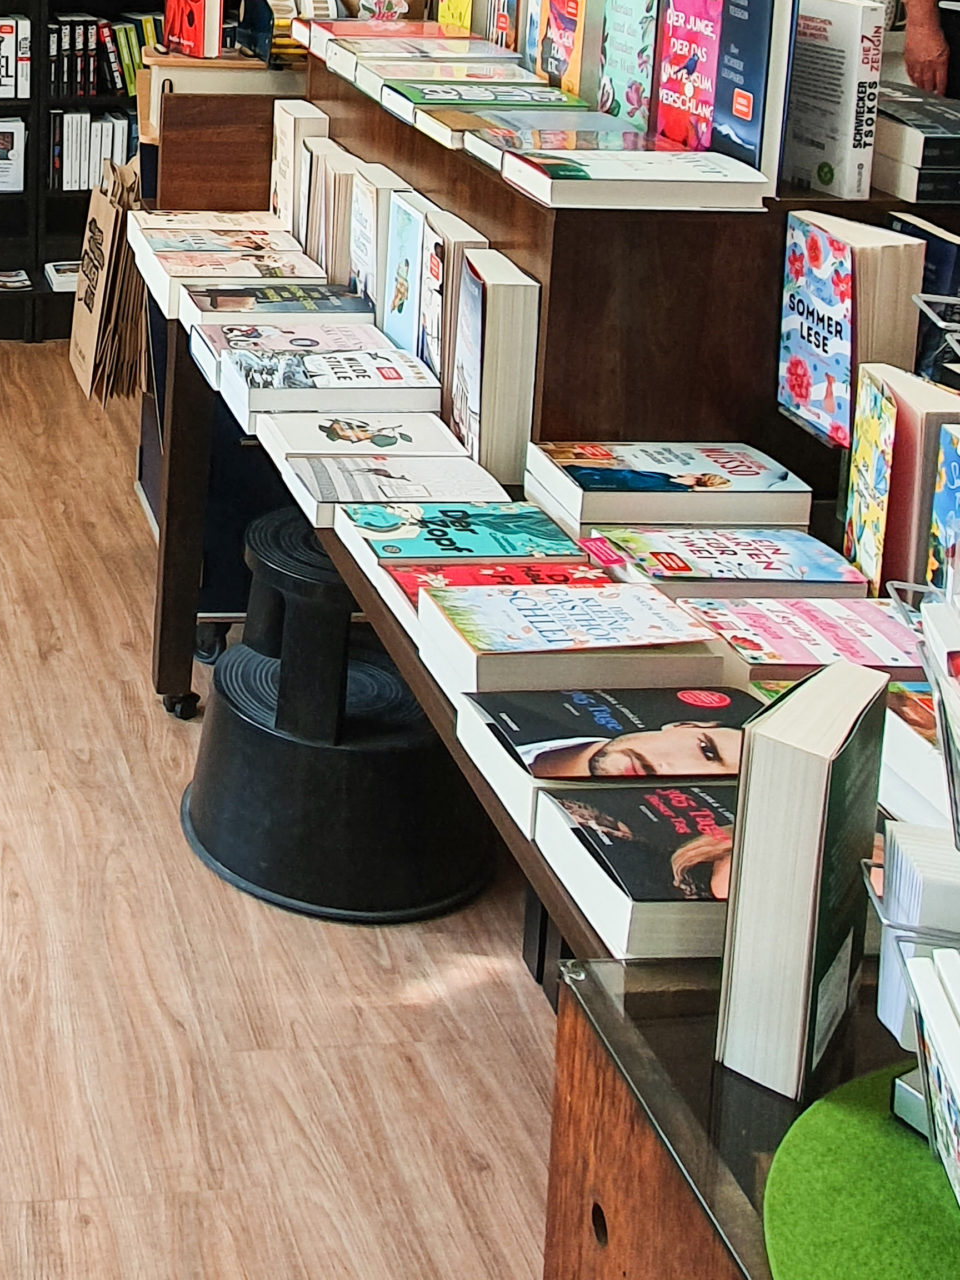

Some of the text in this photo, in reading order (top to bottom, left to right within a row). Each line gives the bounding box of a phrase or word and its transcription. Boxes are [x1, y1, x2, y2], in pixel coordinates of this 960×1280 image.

[666, 8, 717, 40] DER JUNGE,
[670, 37, 707, 63] DER DAS
[861, 34, 874, 65] DIE 7
[869, 25, 883, 72] ZEUGIN
[659, 87, 715, 120] VERSCHLANG
[853, 81, 868, 149] SCHWIECKER
[862, 81, 878, 149] TSOKOS
[788, 293, 843, 340] SOMMER
[800, 322, 829, 354] LESE
[322, 356, 353, 381] STILLE
[343, 357, 371, 380] WILDE
[694, 448, 760, 476] MUSSO
[417, 517, 475, 553] Zopf
[438, 509, 479, 535] Der
[667, 535, 718, 559] ZWEI
[696, 537, 738, 556] FÜR
[712, 531, 783, 571] GARTEN
[751, 539, 790, 555] EIN
[506, 589, 575, 644] SCHLEI
[545, 588, 621, 643] GASTHOF
[578, 597, 630, 633] KLEINE
[608, 606, 635, 622] DER
[588, 703, 624, 732] Tage
[655, 789, 697, 807] 365
[688, 808, 733, 843] Tage
